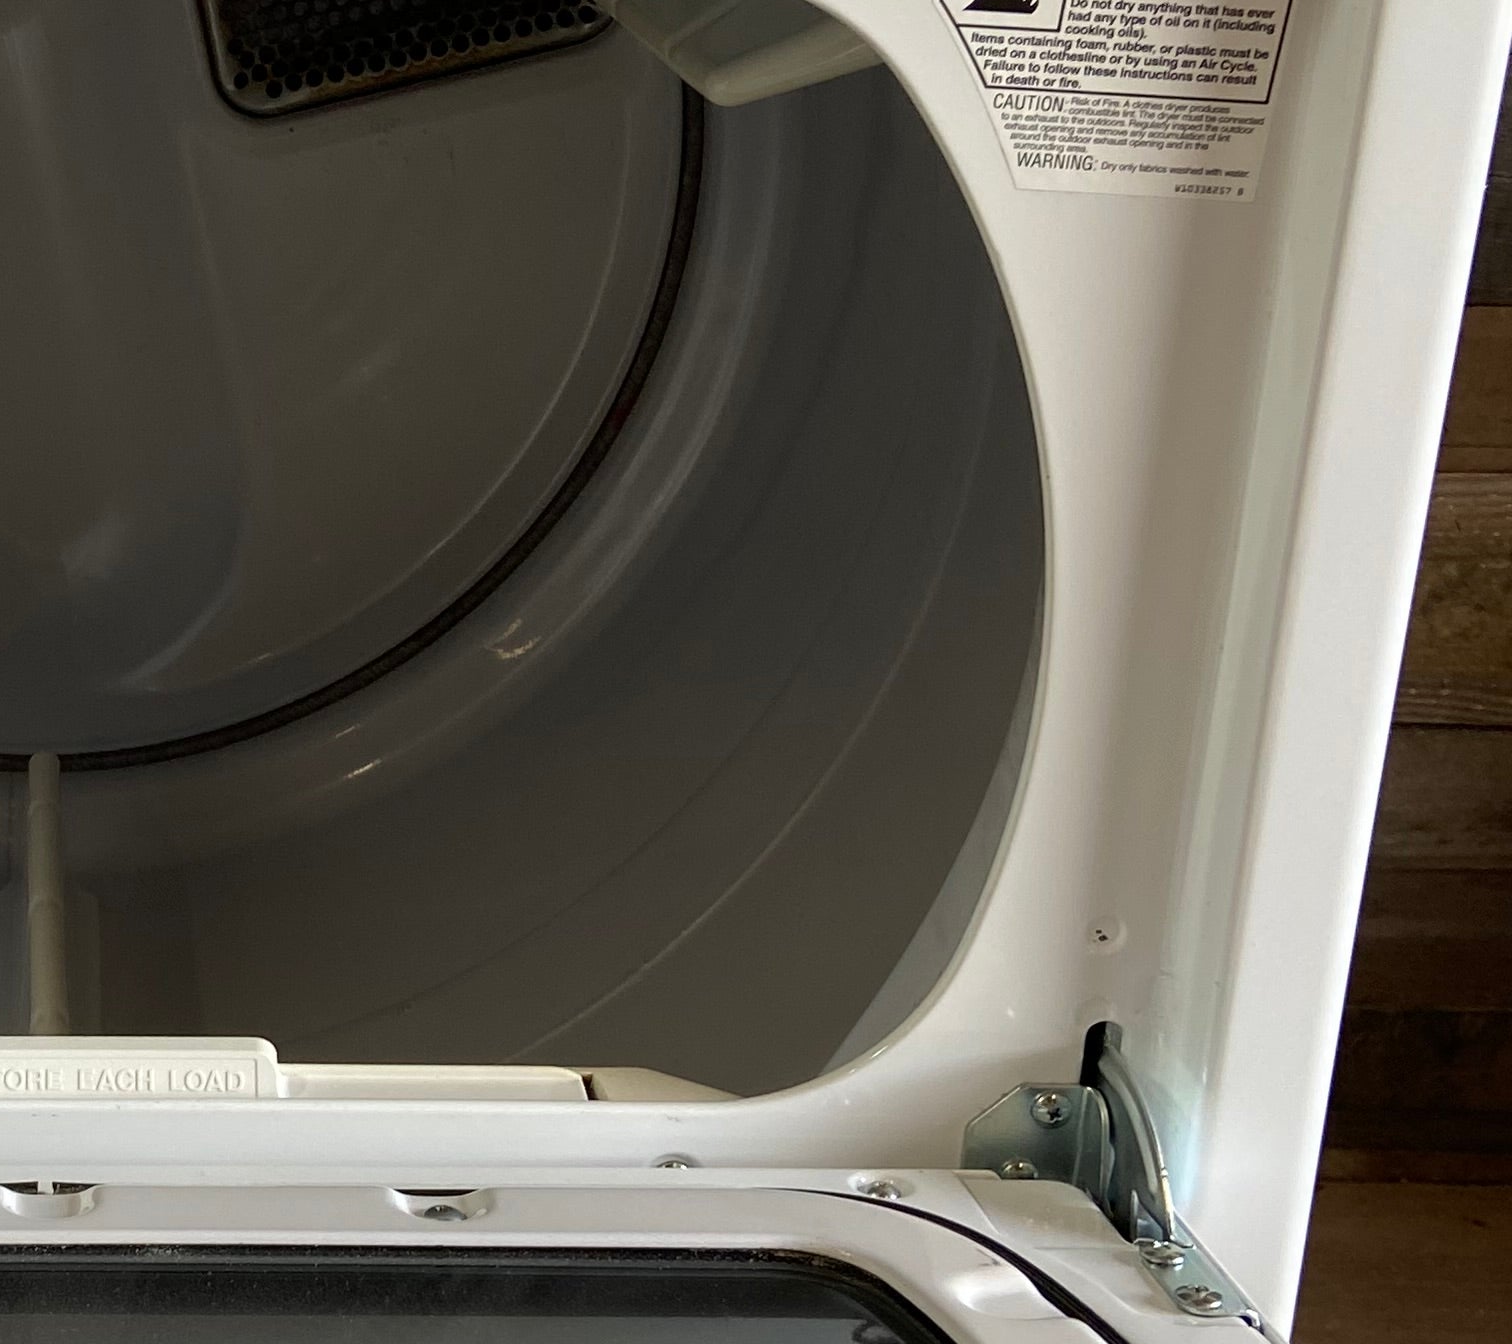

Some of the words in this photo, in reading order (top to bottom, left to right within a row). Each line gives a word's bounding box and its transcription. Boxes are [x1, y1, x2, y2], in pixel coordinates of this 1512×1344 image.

[1090, 0, 1113, 10] not
[1114, 0, 1136, 14] dry
[1137, 2, 1193, 17] anything
[1195, 4, 1219, 16] that
[1222, 6, 1244, 17] has
[1247, 10, 1275, 19] ever
[1064, 24, 1116, 40] cooking
[1117, 26, 1147, 41] oils).
[1067, 10, 1093, 22] had
[1093, 14, 1118, 26] any
[1119, 13, 1147, 27] type
[1149, 15, 1164, 26] of
[1165, 16, 1181, 27] oil
[1183, 19, 1200, 28] on
[1202, 18, 1211, 29] it
[1213, 18, 1276, 35] (including
[76, 1067, 153, 1093] EACH
[168, 1067, 245, 1093] LOAD
